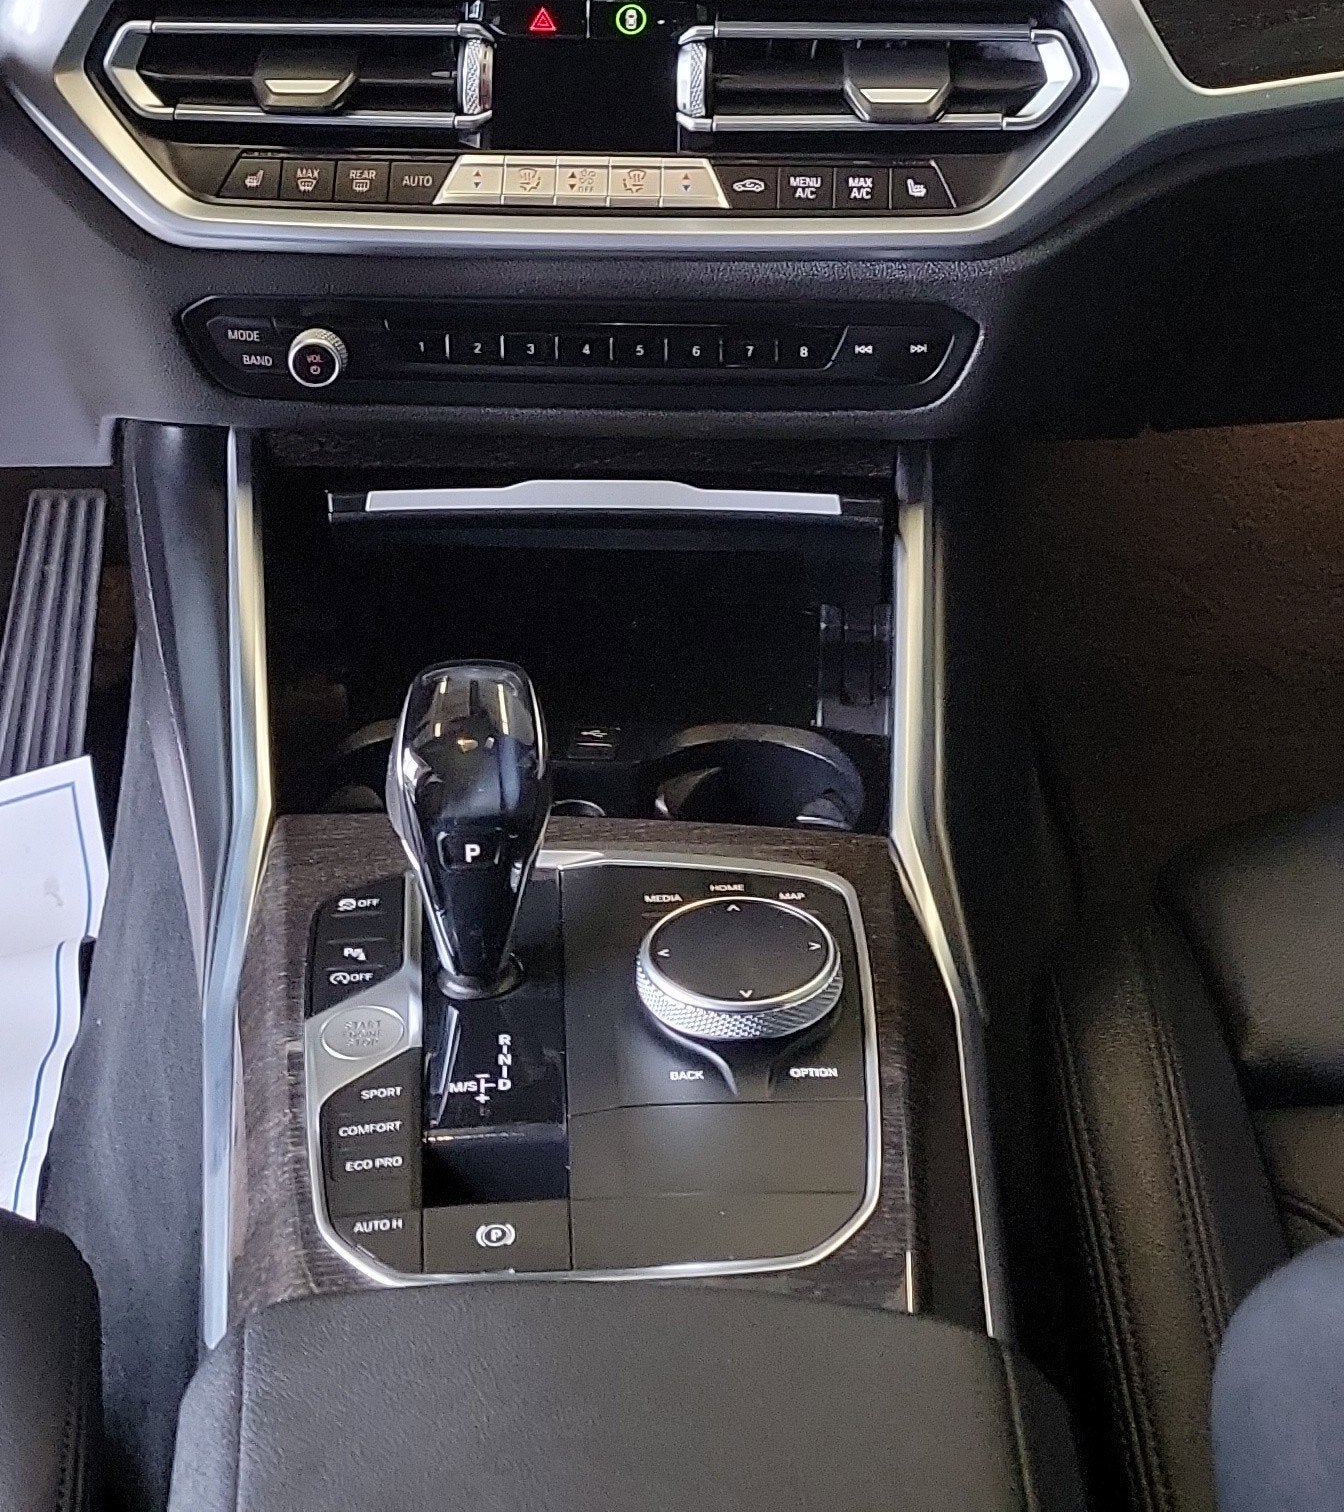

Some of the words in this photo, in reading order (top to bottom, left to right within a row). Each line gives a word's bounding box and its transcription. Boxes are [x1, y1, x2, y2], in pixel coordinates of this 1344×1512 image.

[296, 168, 319, 179] MAX
[349, 169, 376, 180] REAR
[402, 174, 433, 188] AUTO
[789, 176, 822, 188] MENU
[848, 176, 873, 188] MAX
[794, 187, 817, 199] A/C
[850, 187, 872, 199] A/C
[227, 329, 261, 342] MODE
[418, 341, 426, 353] 1
[473, 342, 483, 354] 2
[526, 343, 536, 355] 3
[581, 343, 591, 355] 4
[635, 344, 645, 356] 5
[691, 345, 701, 357] 6
[745, 345, 755, 358] 7
[799, 345, 810, 358] 8
[243, 354, 273, 367] BAND
[306, 354, 324, 364] VOL
[464, 843, 481, 863] P
[709, 883, 745, 892] HOME
[643, 893, 683, 903] MEDIA
[778, 891, 806, 901] MAP
[357, 898, 380, 908] OFF
[350, 972, 374, 983] OFF
[344, 1020, 381, 1030] START
[498, 1033, 512, 1046] R
[498, 1053, 512, 1066] N
[669, 1070, 704, 1081] BACK
[789, 1067, 839, 1078] OPTION
[449, 1081, 478, 1094] M/S
[498, 1078, 512, 1091] D
[360, 1086, 403, 1100] SPORT
[338, 1120, 403, 1137] COMFORT
[345, 1158, 374, 1172] ECO
[374, 1155, 404, 1170] PRO
[353, 1219, 391, 1234] AUTO
[391, 1217, 404, 1231] H
